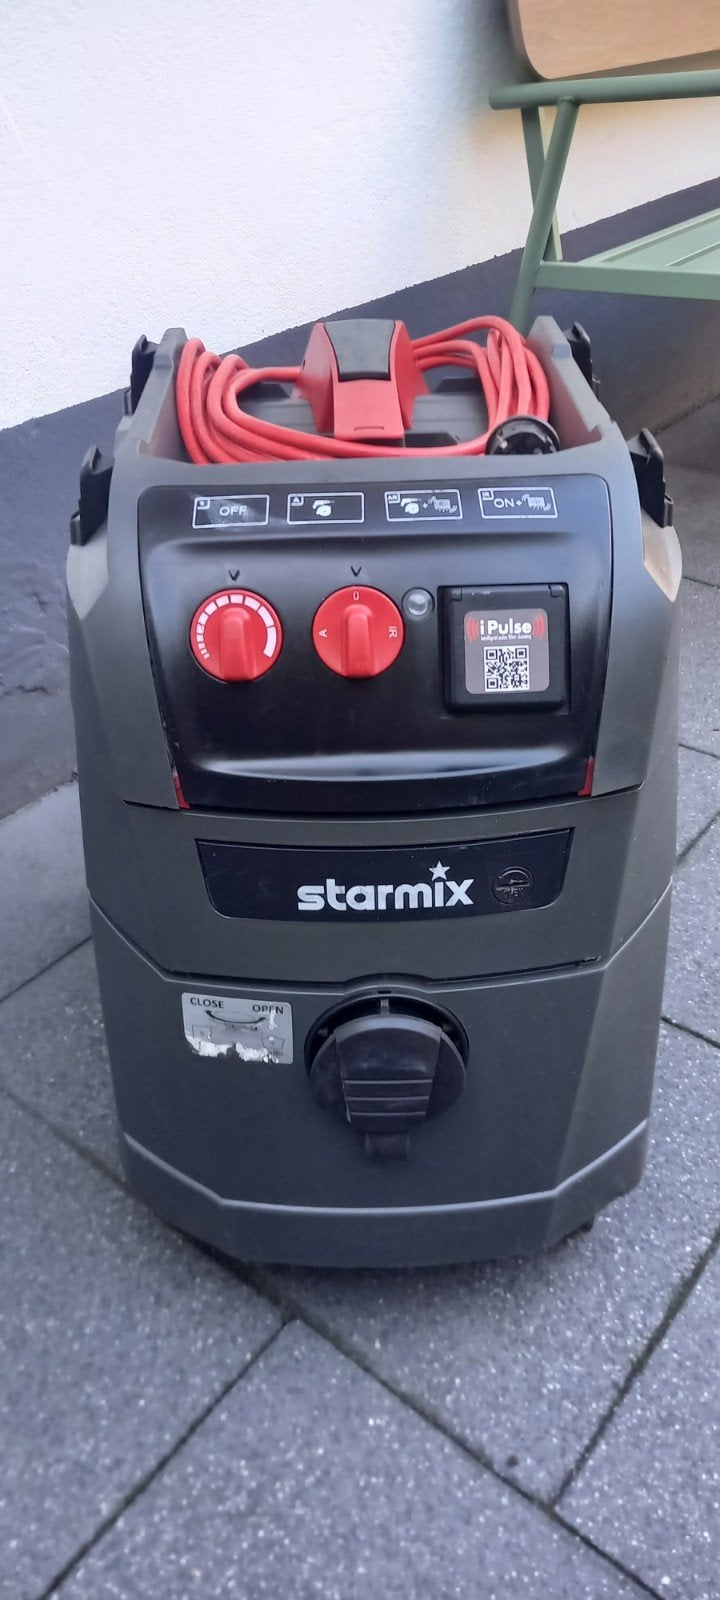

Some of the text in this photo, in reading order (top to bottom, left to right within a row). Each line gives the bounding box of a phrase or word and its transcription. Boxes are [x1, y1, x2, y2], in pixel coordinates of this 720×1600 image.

[292, 496, 300, 504] A
[219, 505, 248, 517] OFF
[480, 617, 532, 636] i Pulse
[318, 628, 328, 638] A
[296, 860, 475, 911] starmix
[190, 997, 224, 1010] CLOSE
